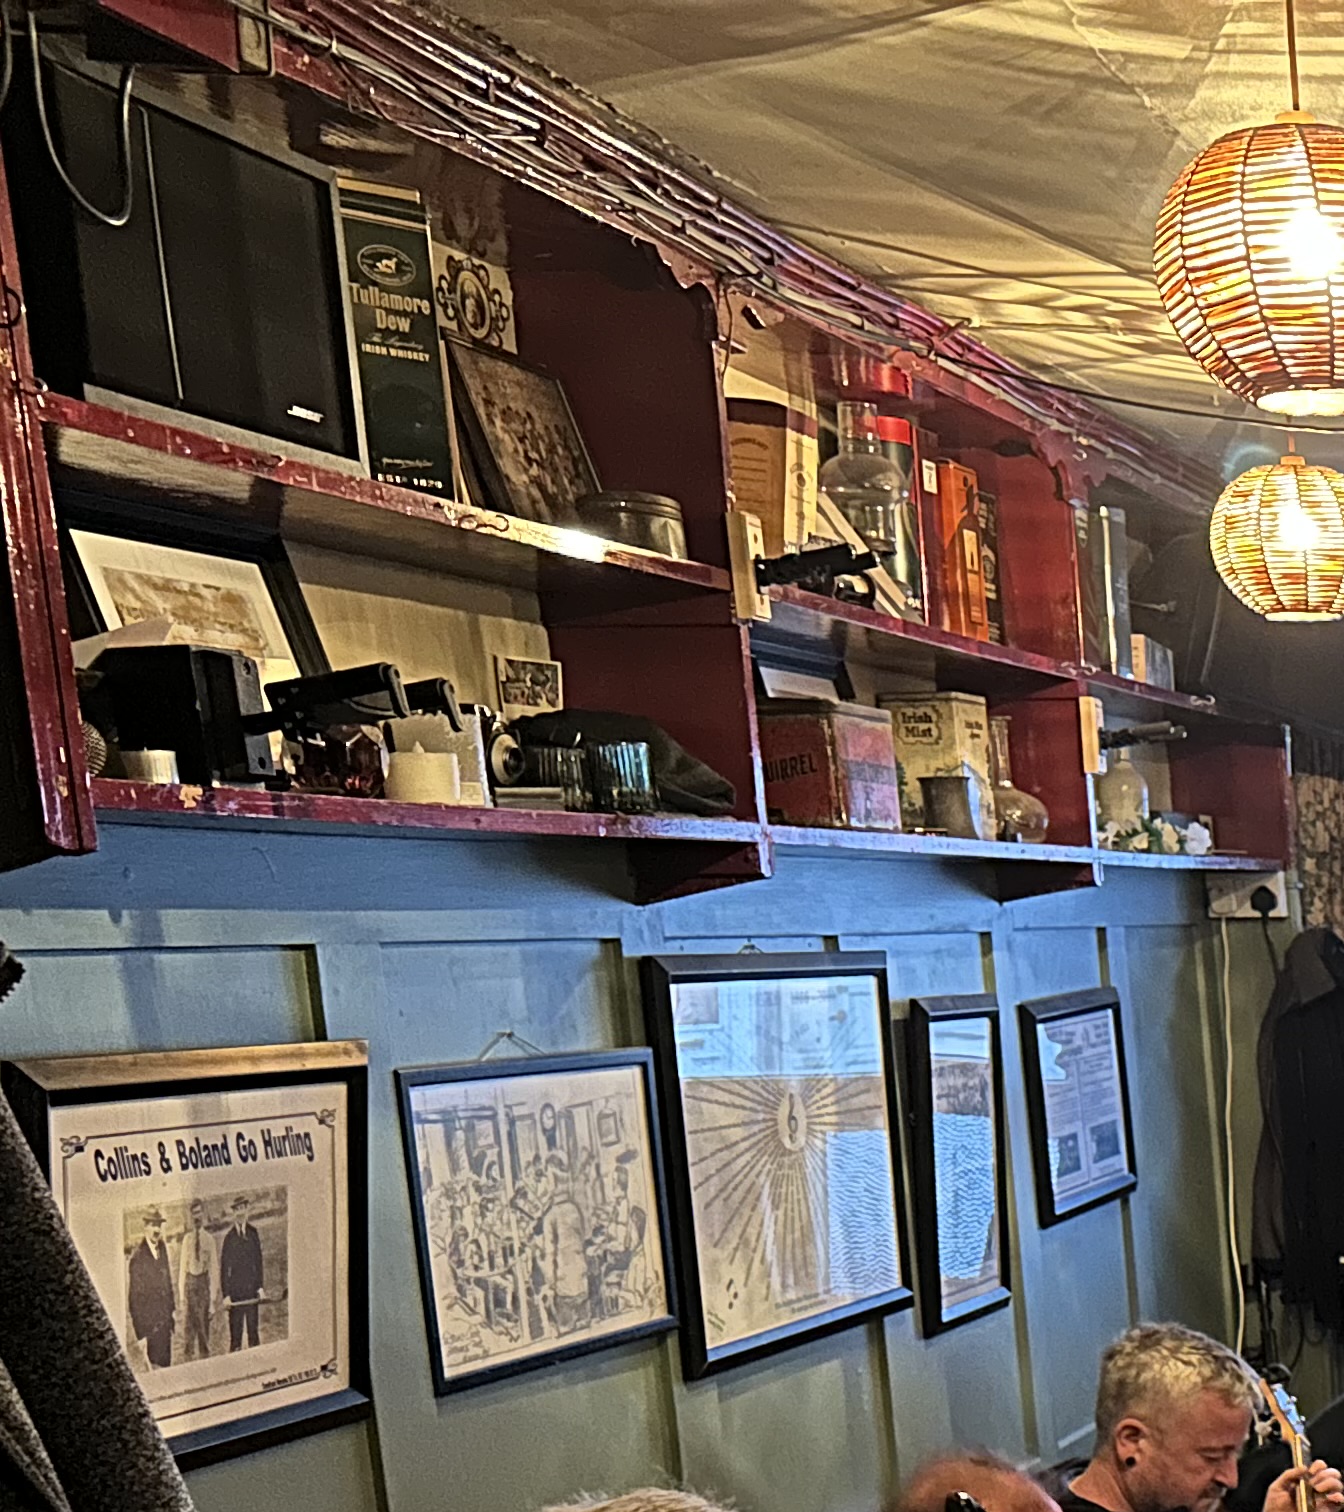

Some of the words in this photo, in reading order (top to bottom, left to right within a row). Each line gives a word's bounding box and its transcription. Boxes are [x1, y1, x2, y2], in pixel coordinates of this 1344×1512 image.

[348, 281, 431, 315] Tullamore
[375, 308, 411, 333] Dew
[901, 711, 933, 724] Irish
[904, 725, 934, 738] Mist
[762, 753, 818, 783] UIRREL
[94, 1146, 152, 1182] Collins
[157, 1141, 173, 1174] &
[175, 1133, 232, 1172] Boland
[235, 1131, 259, 1164] Go
[260, 1125, 315, 1162] Hurling
